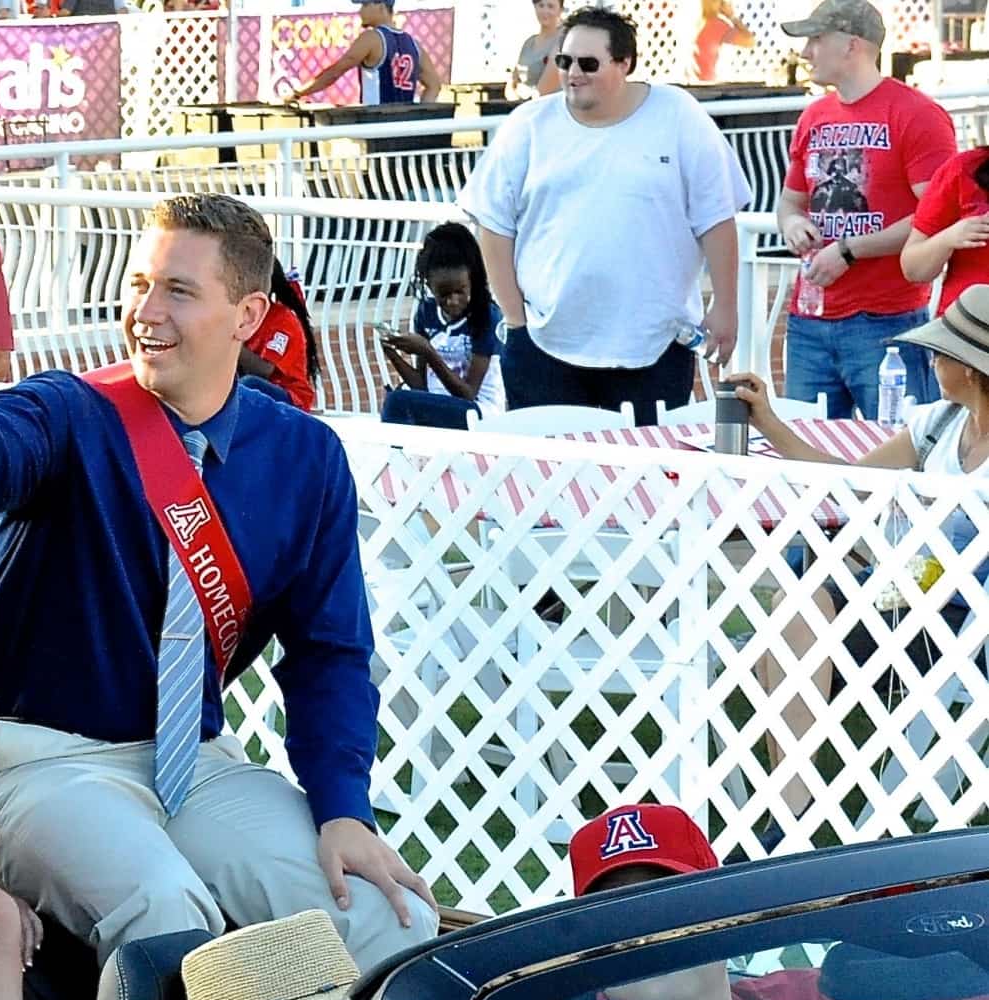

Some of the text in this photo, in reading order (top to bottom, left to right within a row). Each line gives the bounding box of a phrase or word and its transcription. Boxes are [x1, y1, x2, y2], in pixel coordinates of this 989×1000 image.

[807, 122, 892, 152] ARIZONA
[164, 497, 239, 654] A HOMECO
[600, 809, 659, 860] A
